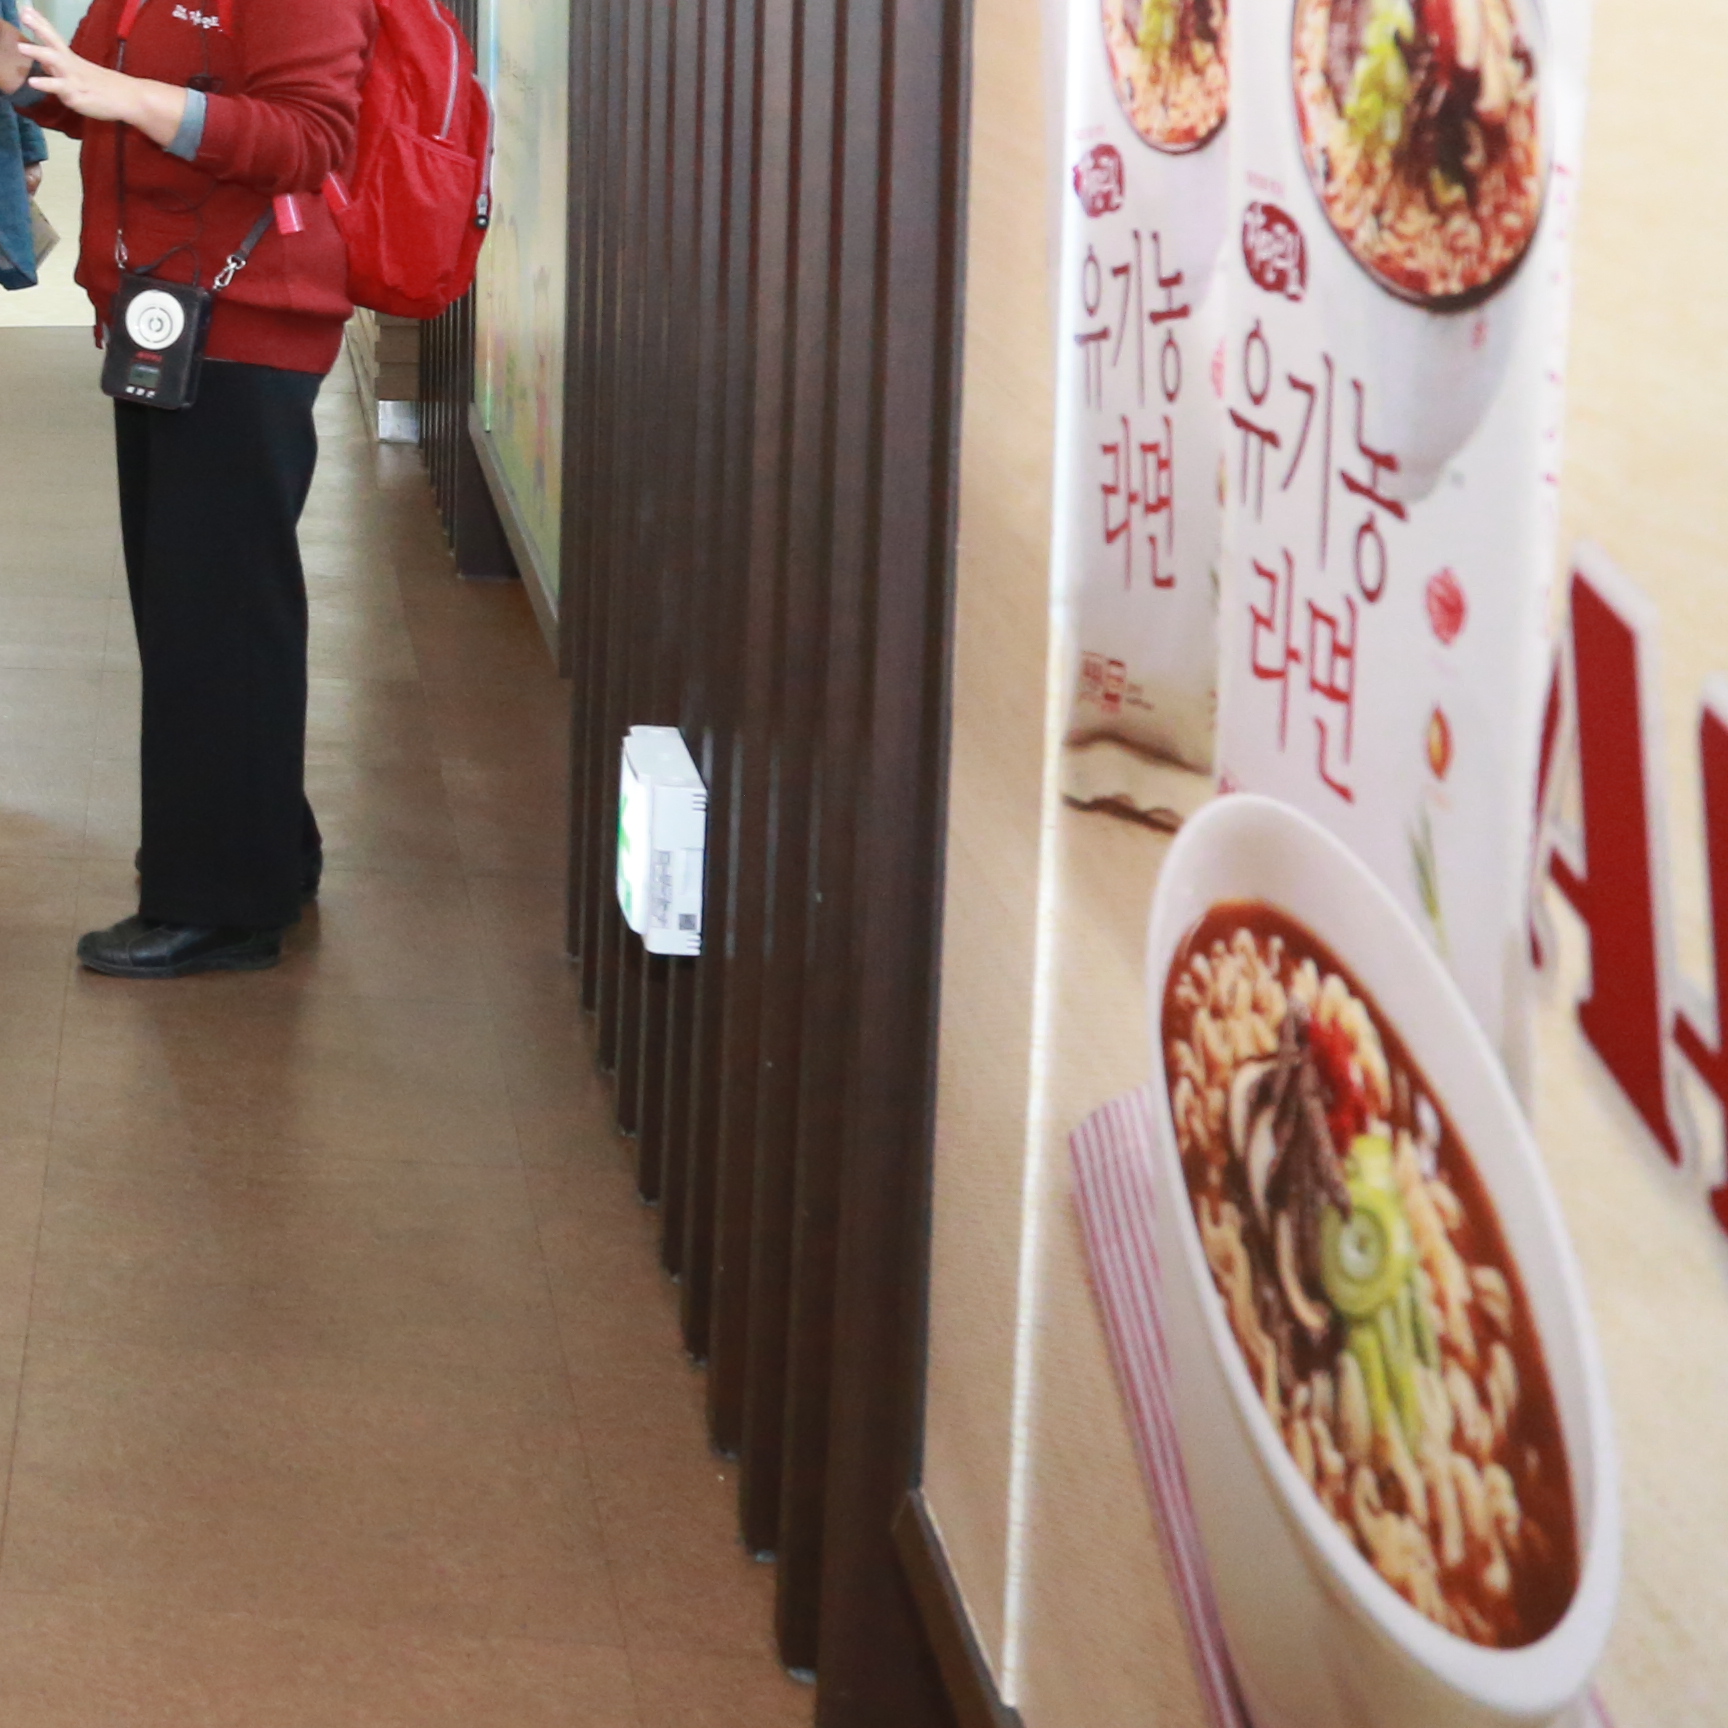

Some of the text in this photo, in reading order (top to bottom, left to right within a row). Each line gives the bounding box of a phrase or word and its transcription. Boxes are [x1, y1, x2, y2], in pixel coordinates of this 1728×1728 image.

[1073, 229, 1191, 410] 유기농
[1098, 414, 1176, 593] 라면
[1229, 316, 1409, 606] 유기농
[1248, 548, 1356, 804] 라면
